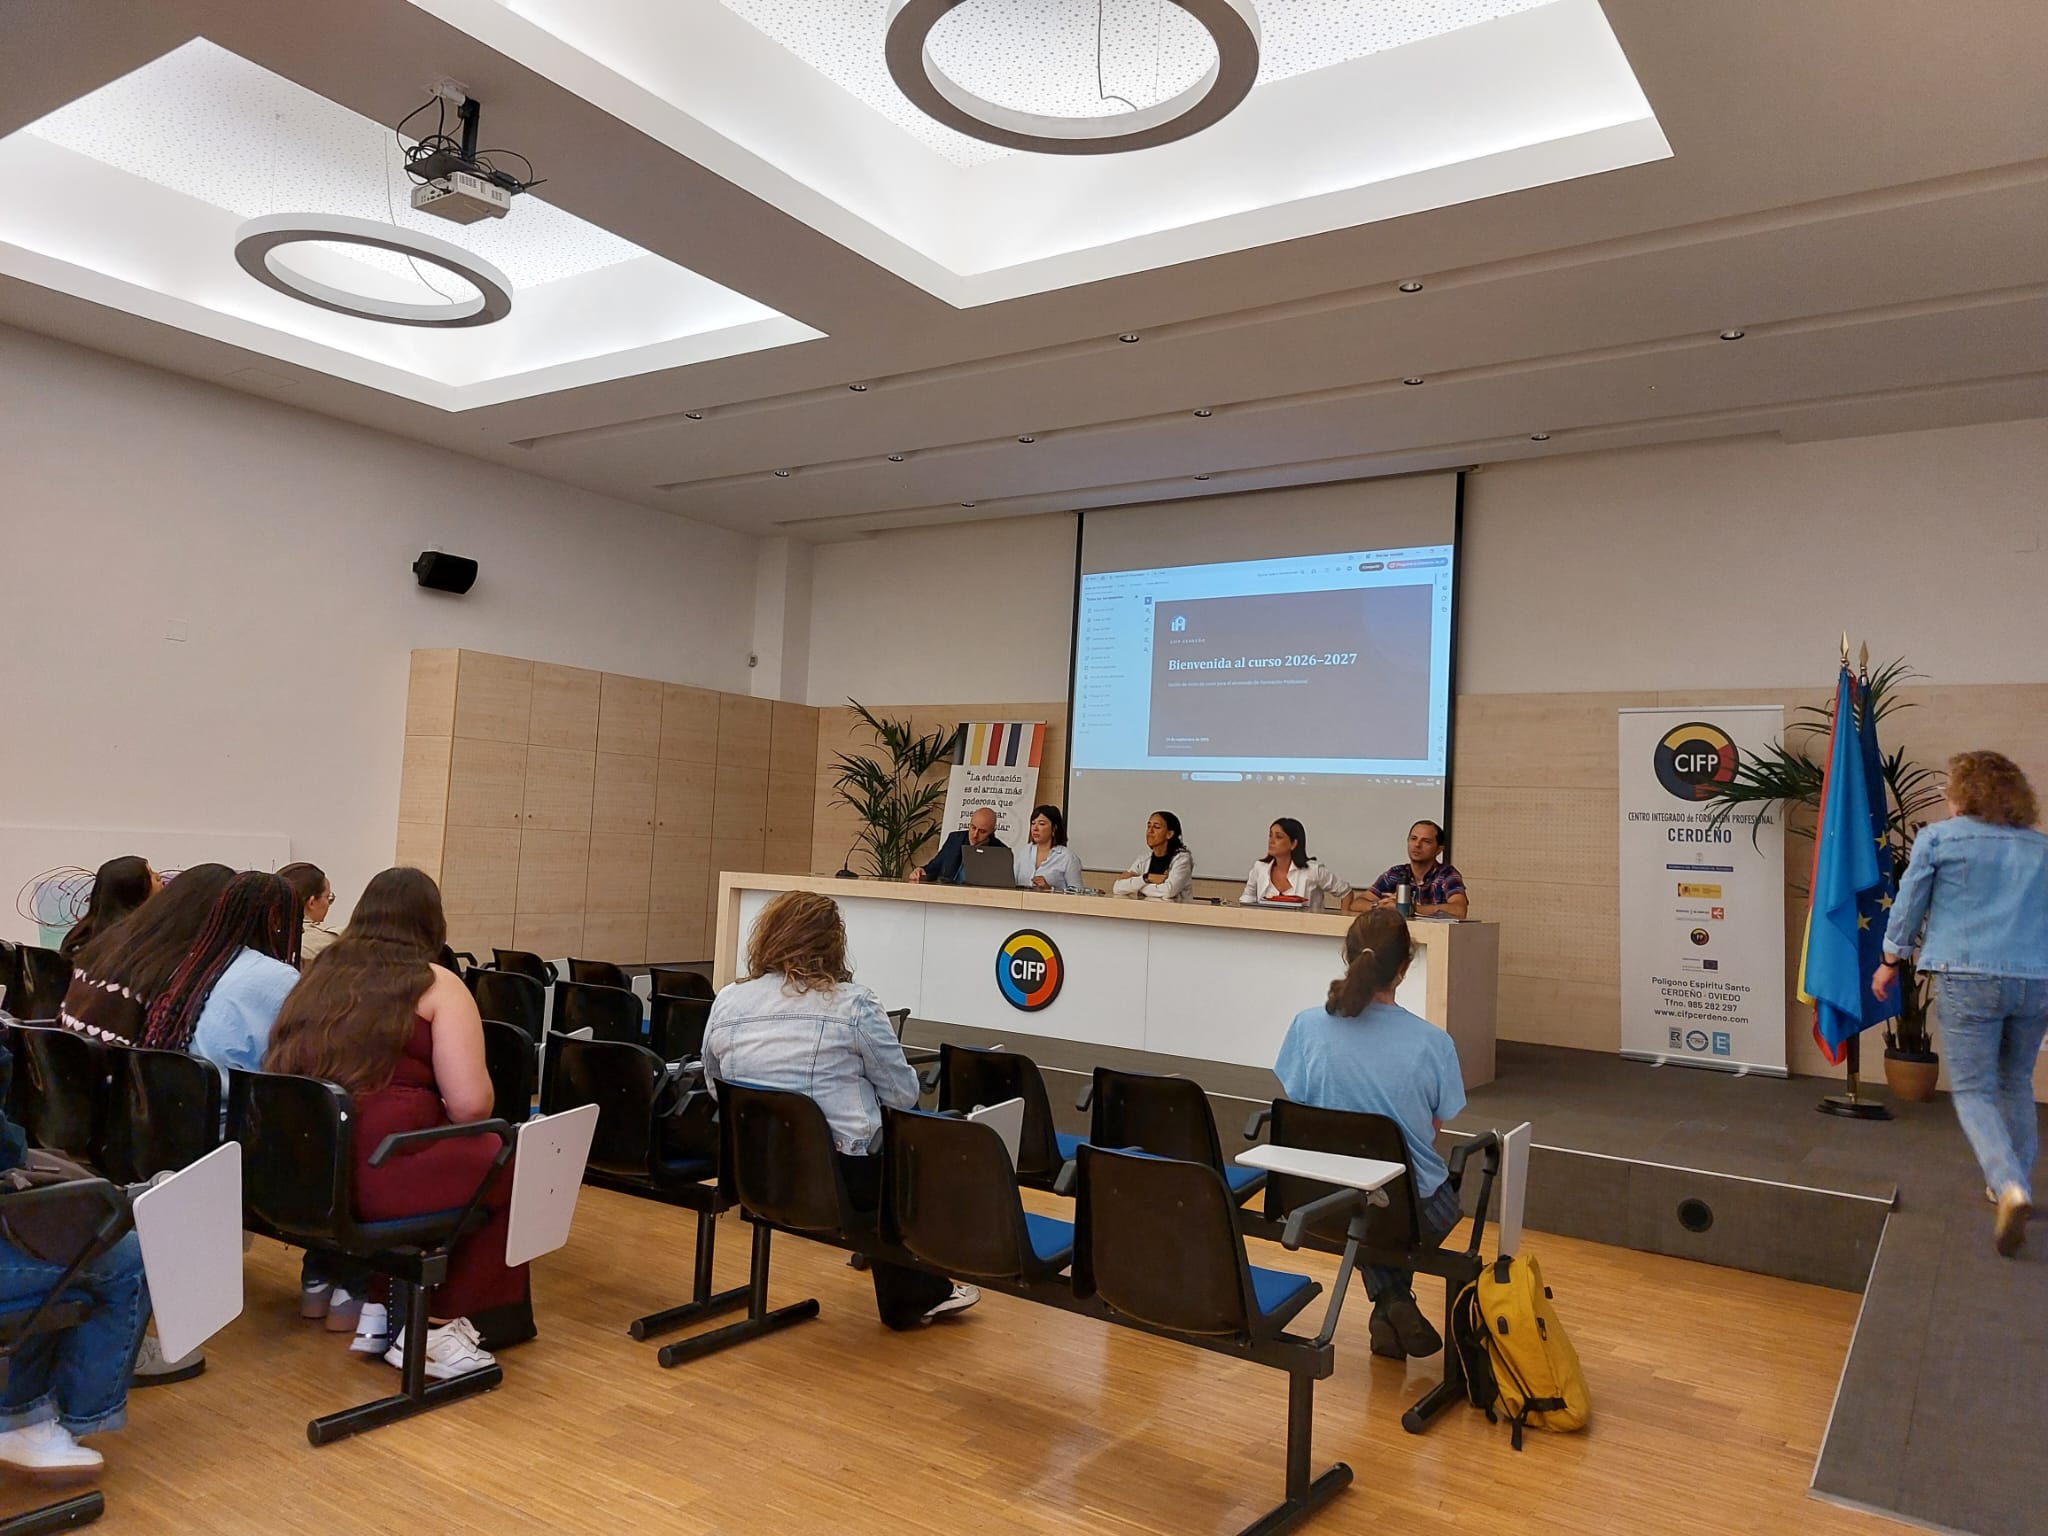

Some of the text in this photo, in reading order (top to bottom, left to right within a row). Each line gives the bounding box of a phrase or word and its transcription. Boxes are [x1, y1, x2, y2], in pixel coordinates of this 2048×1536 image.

[1168, 657, 1232, 670] Bienvenida
[1234, 657, 1245, 668] al
[1248, 658, 1282, 668] curso
[1674, 754, 1719, 772] CIFP
[982, 772, 1022, 783] educación
[973, 785, 980, 793] el
[981, 786, 1003, 794] arma
[1005, 786, 1023, 795] más
[961, 797, 1013, 808] poderosa que
[1628, 812, 1650, 822] CENTRO
[1651, 812, 1685, 823] INTEGRADO
[1686, 813, 1694, 823] de
[1732, 814, 1774, 825] PROFESONAL
[1668, 826, 1732, 843] CERDEÑO
[1011, 959, 1046, 981] CIFP
[1724, 983, 1751, 992] Santo
[1661, 988, 1702, 999] CERDEÑO
[1708, 992, 1741, 1002] OVIEDO
[1664, 998, 1737, 1012] Tfno. 985 282 297
[1654, 1008, 1749, 1024] www.cifpcerdeno.com
